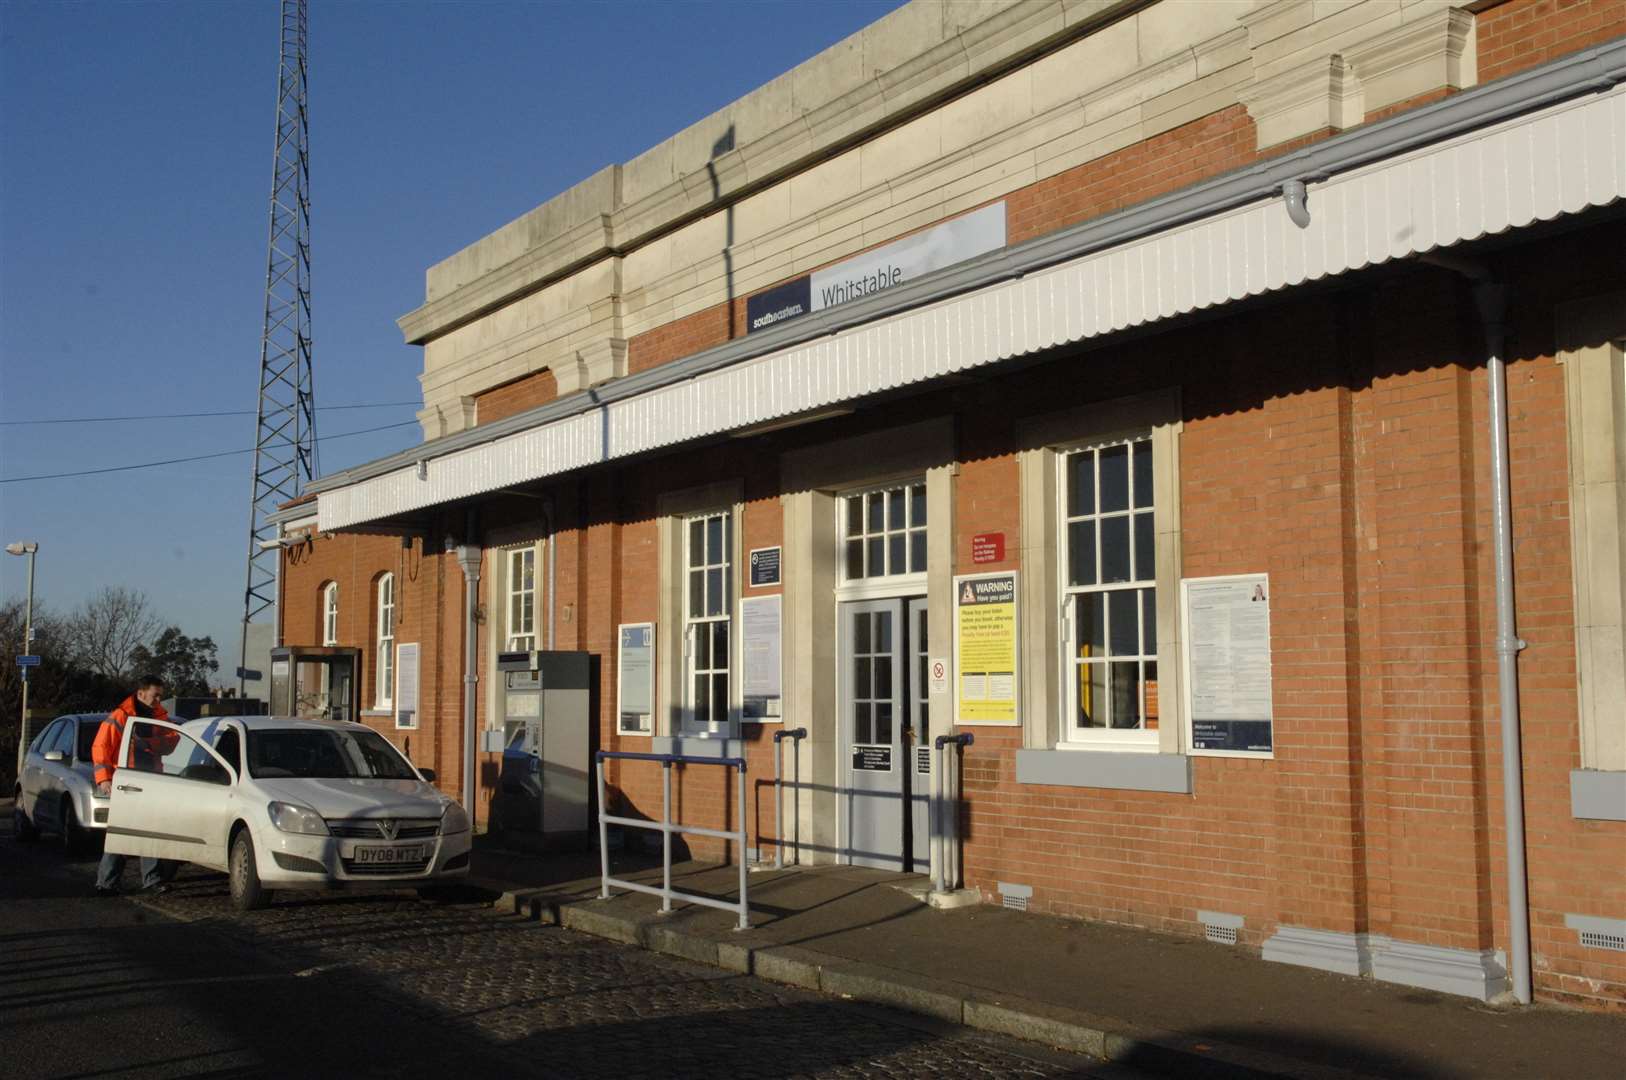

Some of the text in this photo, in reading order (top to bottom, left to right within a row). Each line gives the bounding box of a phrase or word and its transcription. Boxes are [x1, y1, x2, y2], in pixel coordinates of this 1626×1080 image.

[822, 265, 901, 309] Whitstable
[976, 581, 1013, 593] WARNING
[361, 849, 393, 861] DY08
